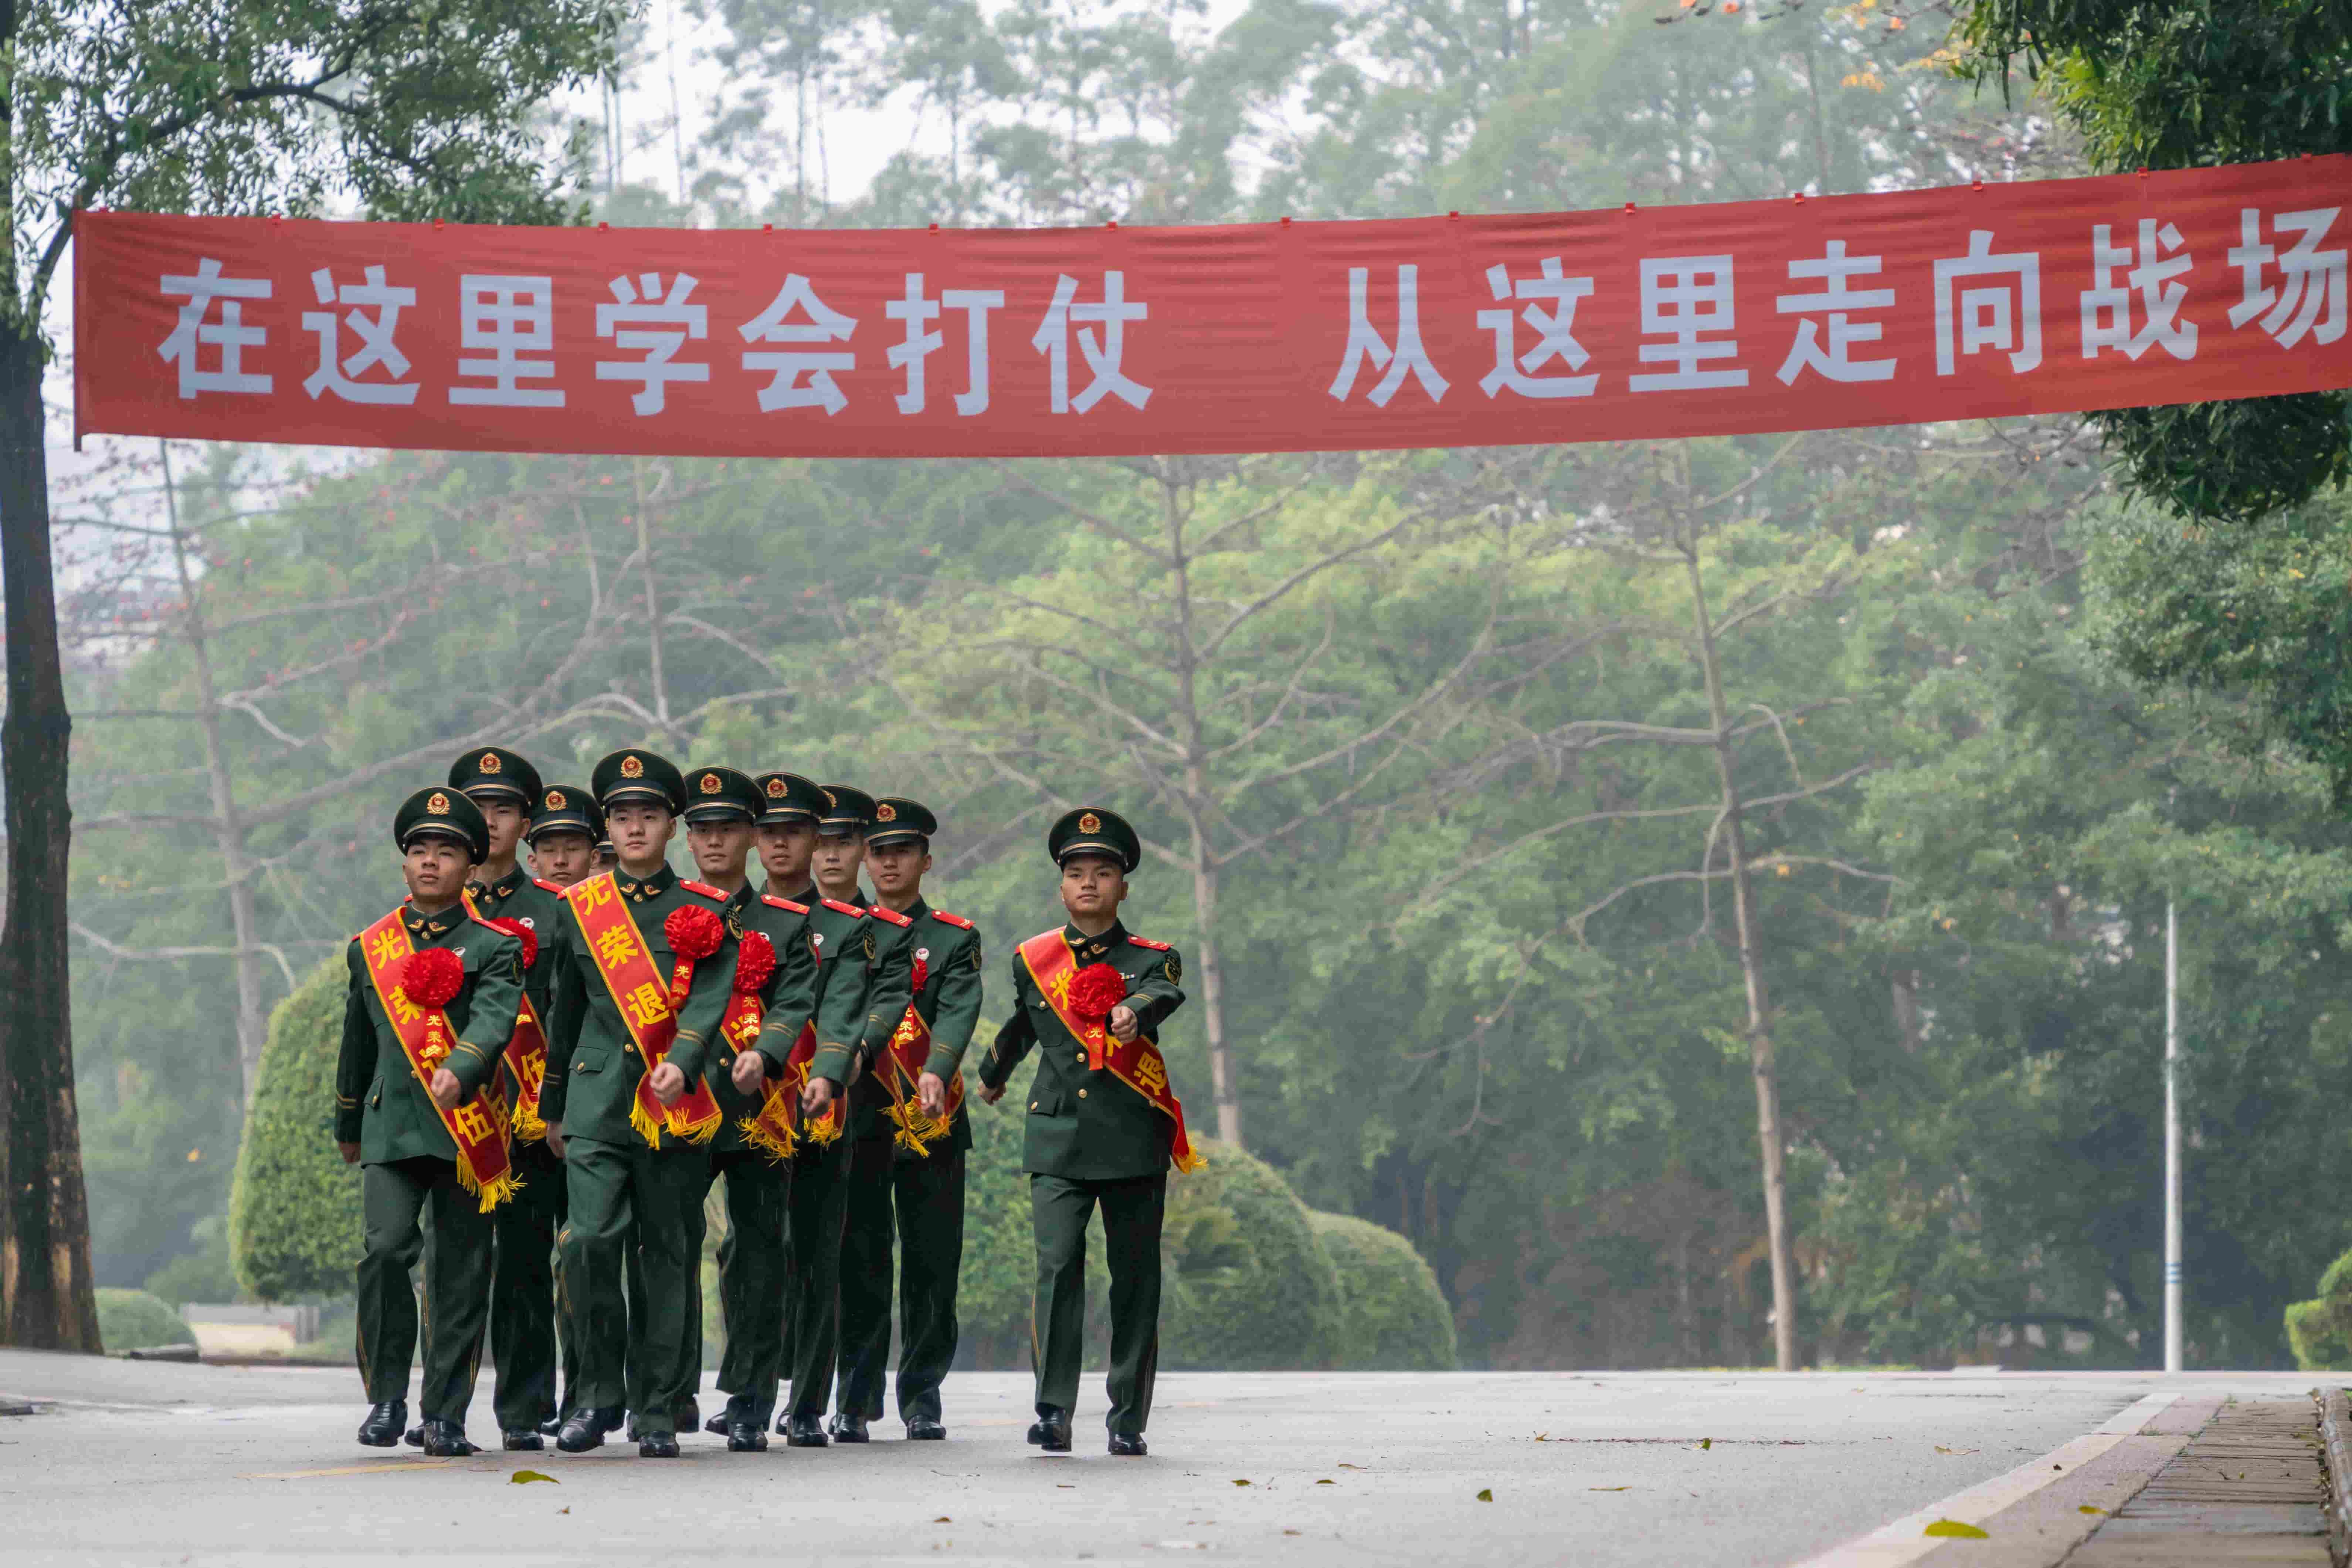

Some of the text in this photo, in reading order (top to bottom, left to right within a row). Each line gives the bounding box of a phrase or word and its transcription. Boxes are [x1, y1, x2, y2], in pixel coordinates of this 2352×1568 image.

[157, 207, 2347, 417] 在这里学会打仗 从这里走向战场
[371, 928, 494, 1147] 光荣伍
[577, 876, 670, 1065] 光荣退
